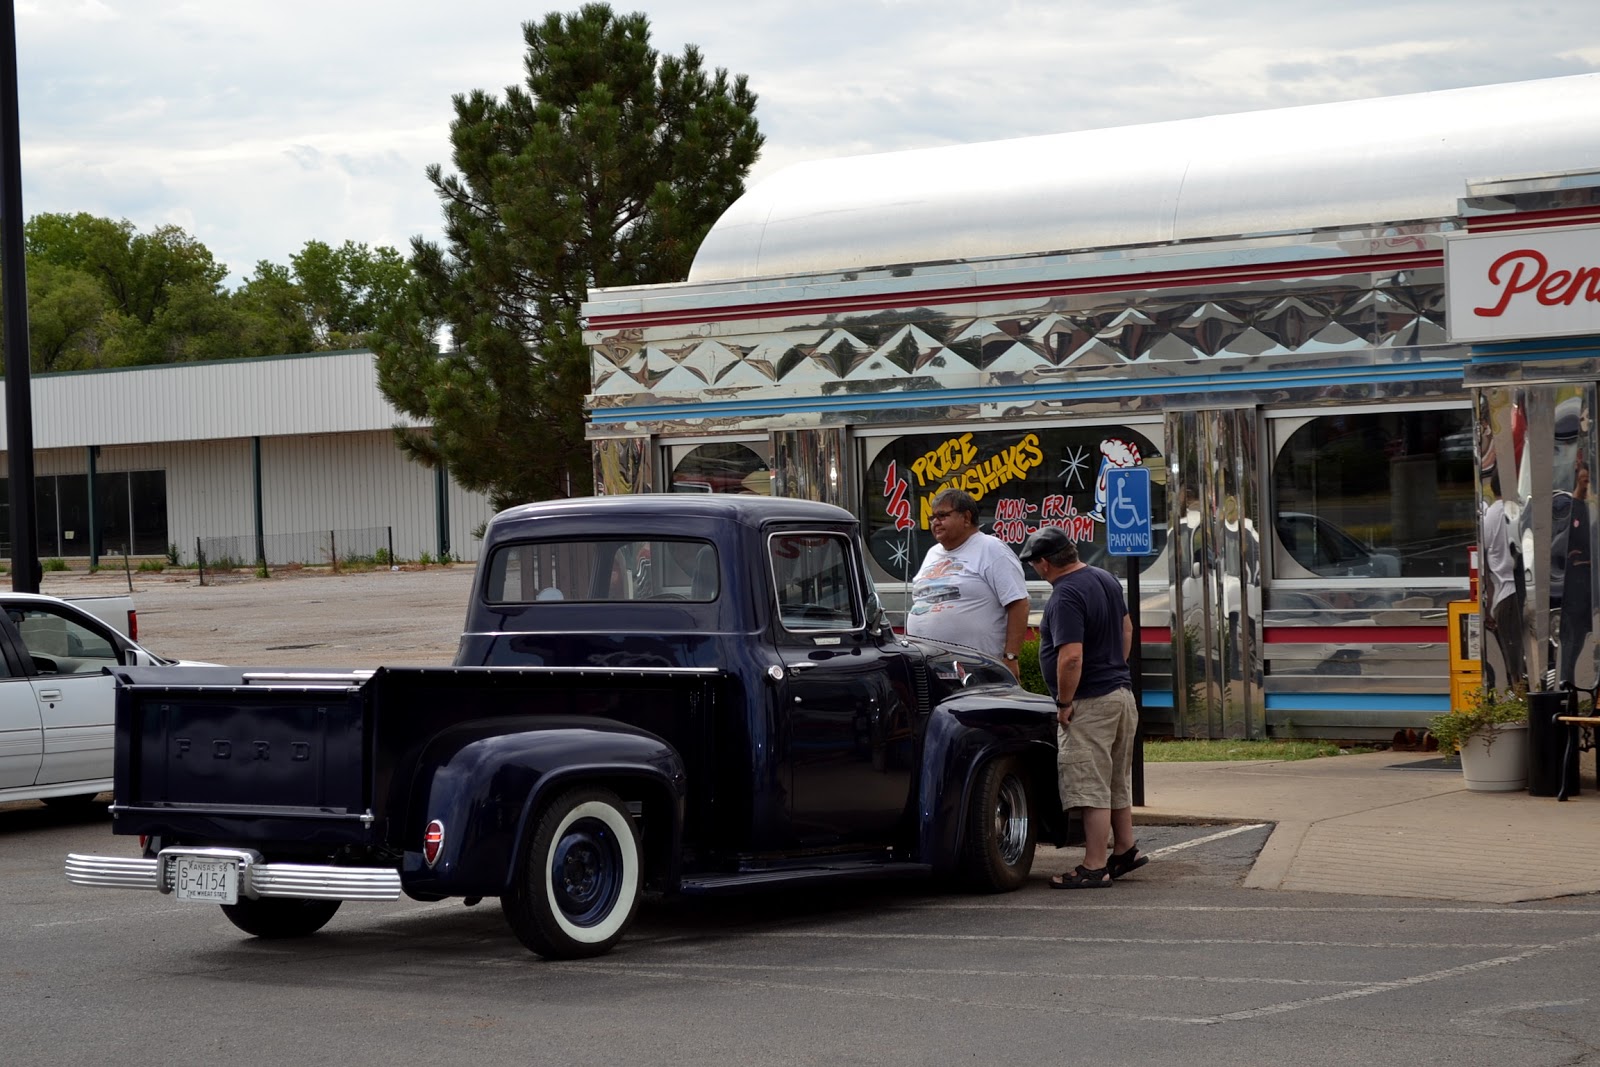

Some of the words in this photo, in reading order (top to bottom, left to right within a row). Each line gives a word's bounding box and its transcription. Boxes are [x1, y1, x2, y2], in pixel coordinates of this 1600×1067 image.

[911, 432, 978, 486] PRICE
[920, 433, 1043, 530] MSHAKES
[884, 459, 916, 532] 1/2
[1041, 494, 1077, 518] FRI.
[1110, 533, 1148, 547] PARKING
[174, 738, 311, 762] FORD
[189, 863, 215, 871] KANSAS
